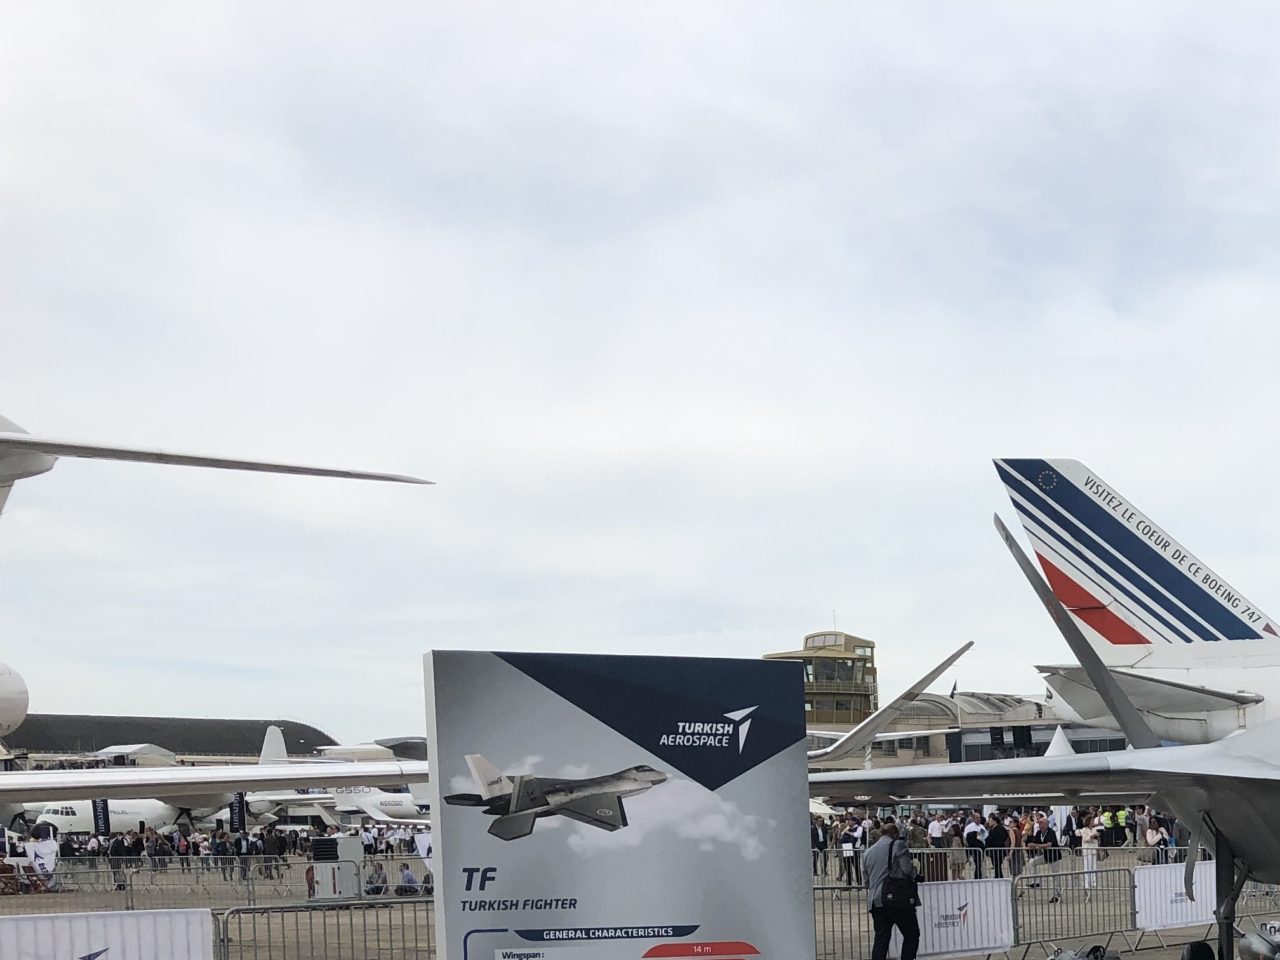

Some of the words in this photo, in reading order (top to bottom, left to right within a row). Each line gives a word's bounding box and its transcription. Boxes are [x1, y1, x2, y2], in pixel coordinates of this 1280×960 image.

[1084, 475, 1123, 512] VISITEZ
[1121, 508, 1136, 523] LE
[1136, 520, 1171, 552] COEUR
[1171, 549, 1188, 566] DE
[1187, 562, 1202, 577] CE
[1201, 573, 1241, 608] BOEING
[1240, 605, 1262, 624] 747
[677, 722, 734, 734] TURKISH
[659, 734, 730, 747] AEROSPACE
[336, 786, 372, 794] G550
[96, 799, 105, 833] lfstream
[462, 867, 497, 891] TF
[460, 900, 520, 912] TURKISH
[522, 898, 578, 910] FIGHTER
[543, 929, 587, 939] GENERAL
[590, 928, 673, 938] CHARACTERISTICS
[502, 951, 540, 960] Wingspan
